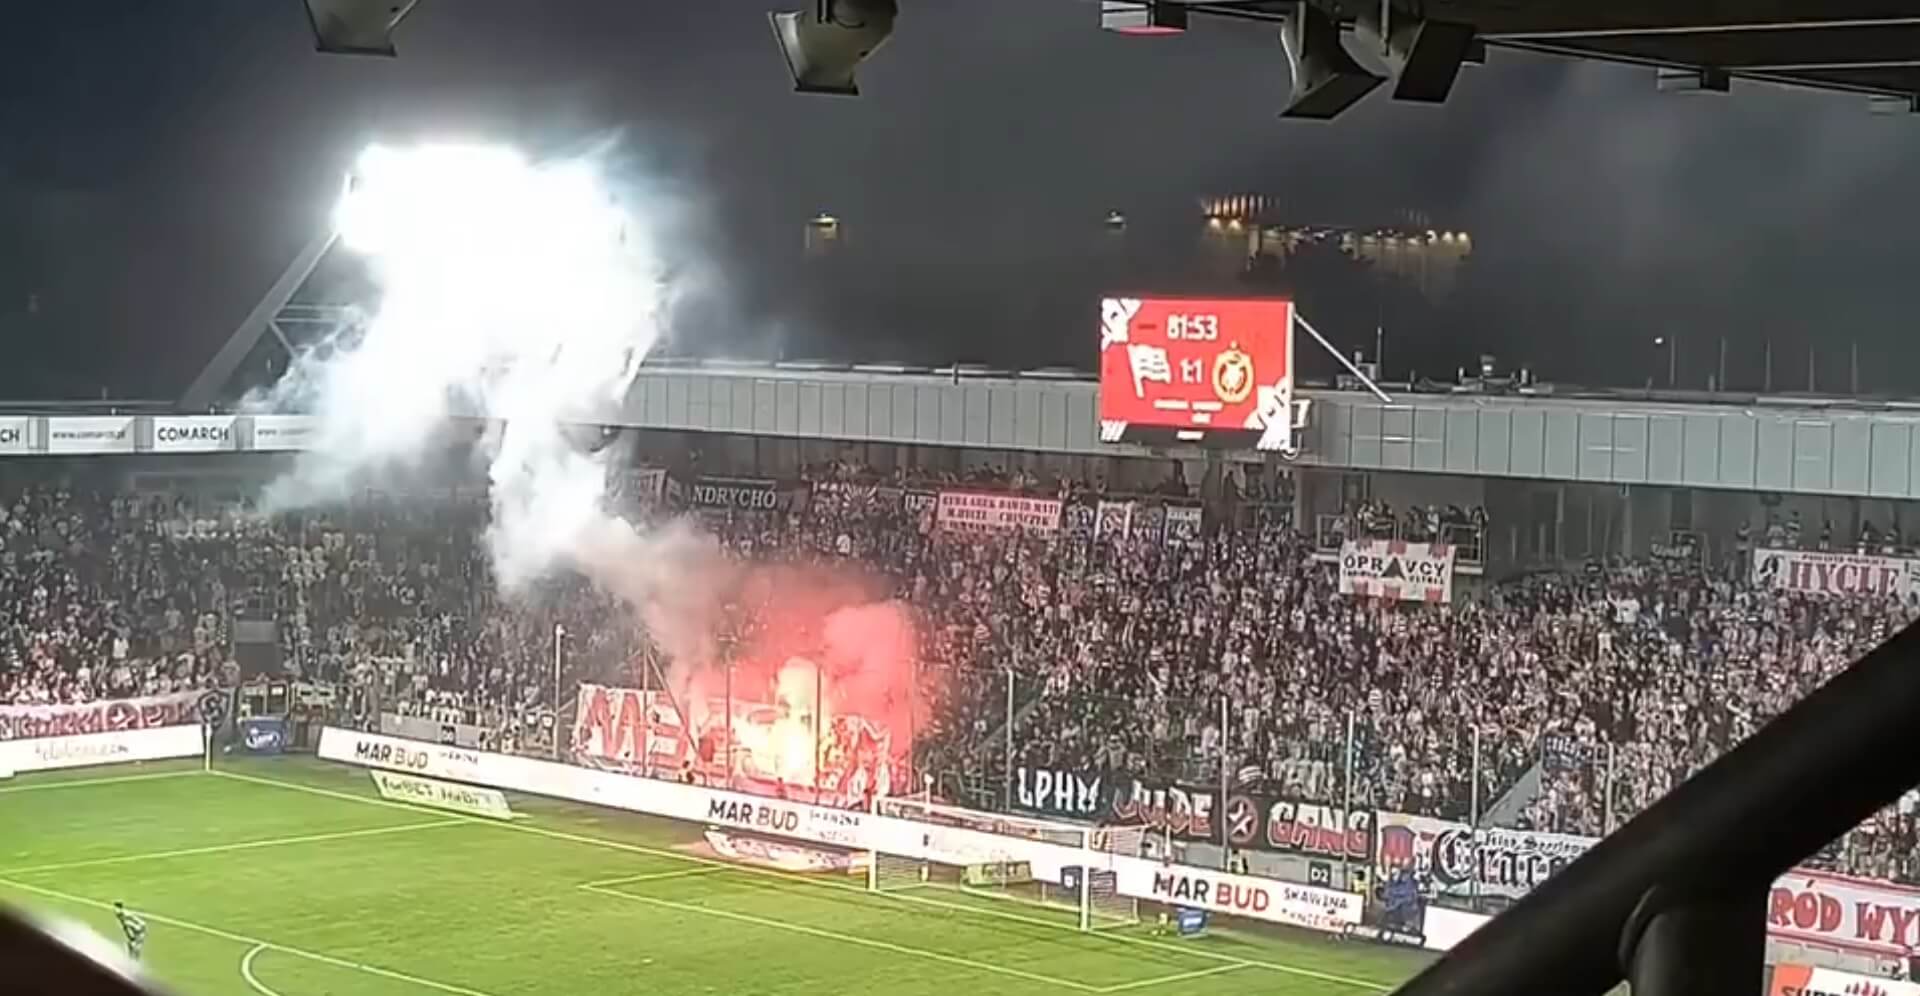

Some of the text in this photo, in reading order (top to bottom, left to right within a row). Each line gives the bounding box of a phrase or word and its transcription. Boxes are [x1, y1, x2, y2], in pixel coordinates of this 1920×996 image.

[1166, 314, 1218, 340] 81:53
[1179, 359, 1203, 383] 1:1
[0, 428, 20, 442] CH
[157, 426, 230, 442] COMARCH
[356, 741, 392, 763] MAR
[395, 747, 429, 770] BUD
[708, 797, 799, 832] MAR BUD
[1267, 801, 1371, 858] GANG
[1311, 866, 1329, 882] D2
[1152, 871, 1269, 912] MAR BUD
[1768, 879, 1920, 949] RÓD WY
